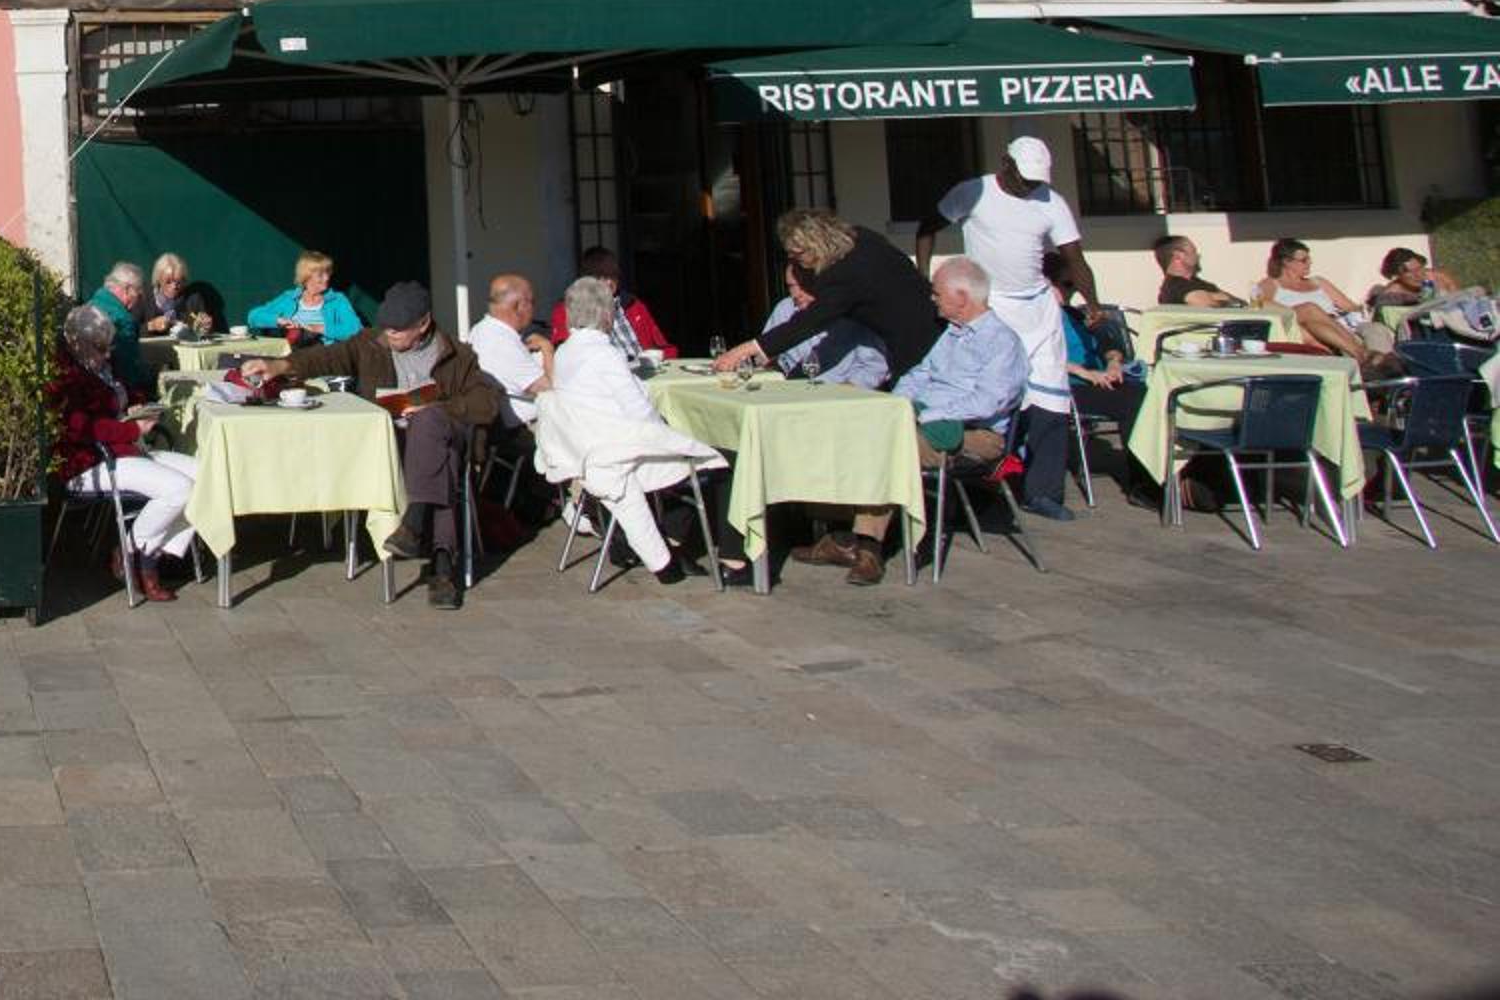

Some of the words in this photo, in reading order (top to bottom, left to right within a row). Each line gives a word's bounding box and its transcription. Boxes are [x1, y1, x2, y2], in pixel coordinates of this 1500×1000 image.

[758, 79, 979, 112] RISTORANTE
[1001, 74, 1153, 105] PIZZERIA
[1460, 64, 1500, 91] ZA
